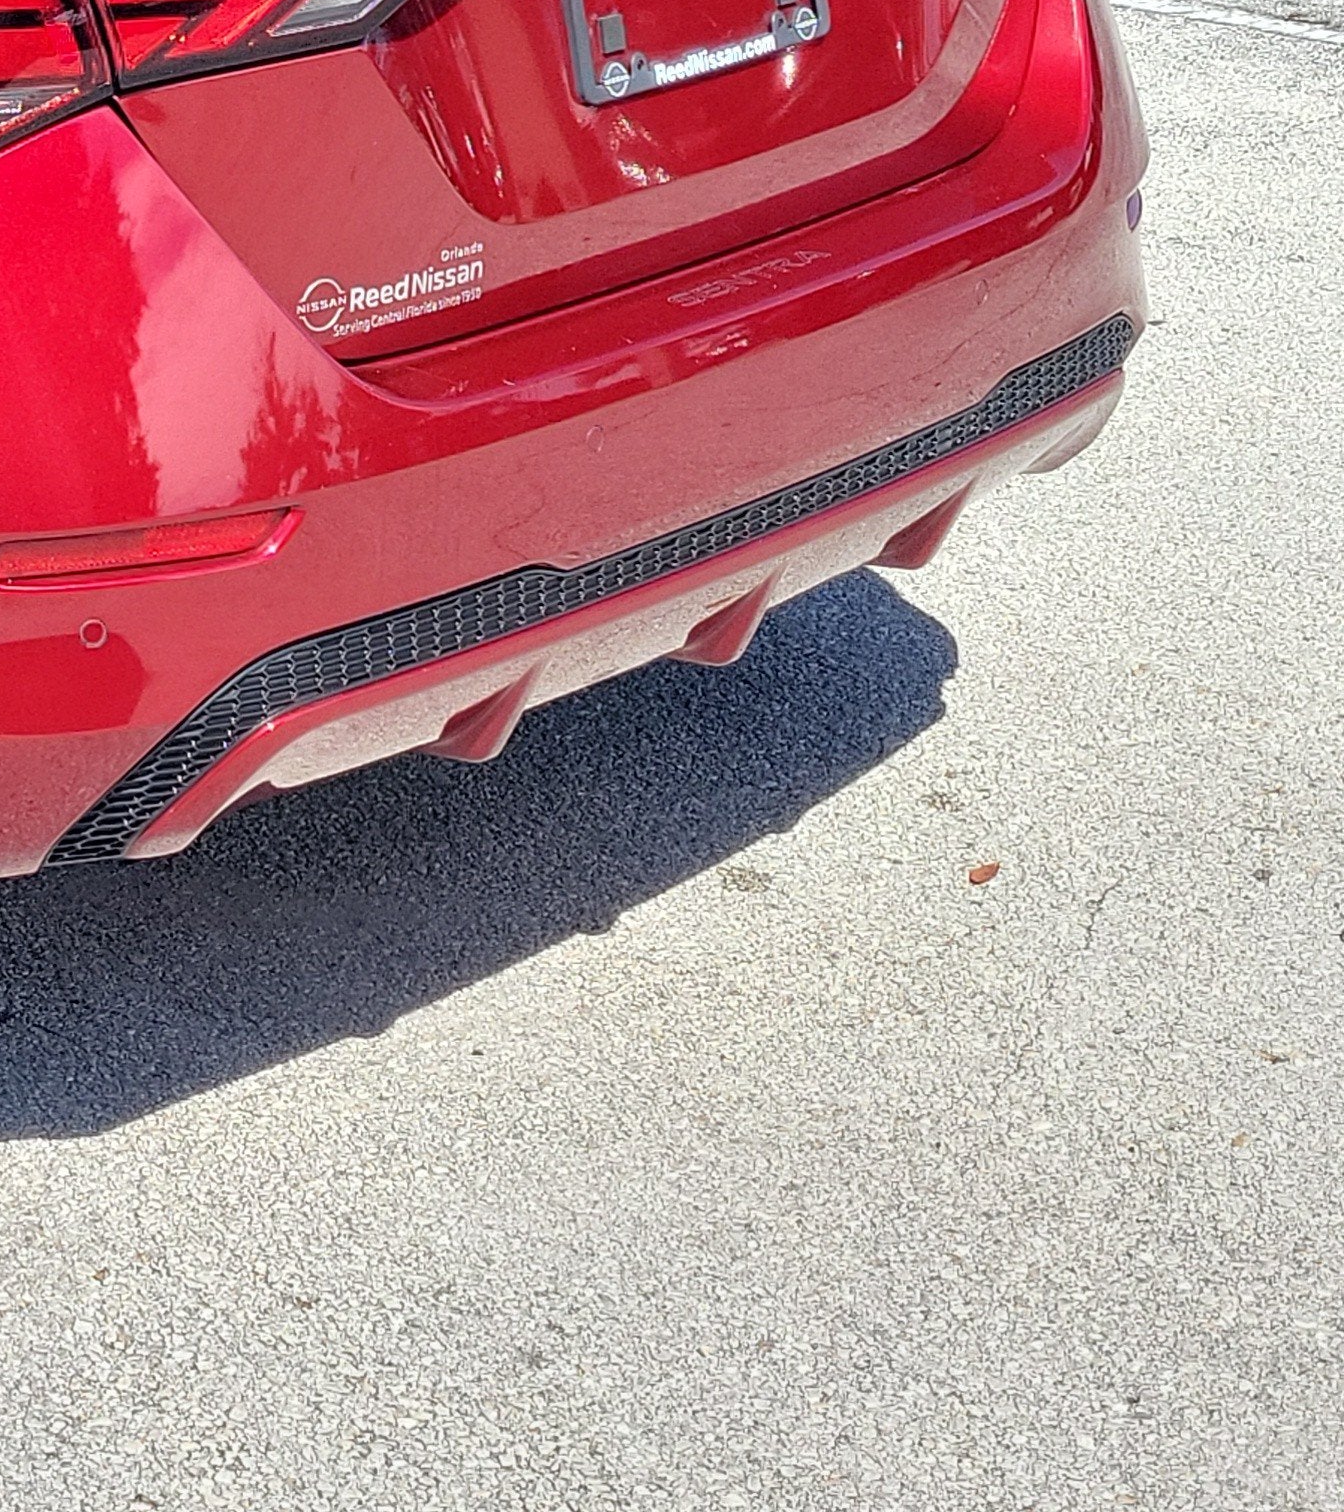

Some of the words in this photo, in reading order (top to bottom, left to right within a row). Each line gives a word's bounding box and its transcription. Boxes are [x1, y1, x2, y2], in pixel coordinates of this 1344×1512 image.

[653, 34, 777, 86] ReedNissan.com
[440, 240, 484, 262] Orlando
[296, 295, 347, 315] NISSAN
[332, 317, 371, 338] Serving
[371, 308, 405, 328] Central
